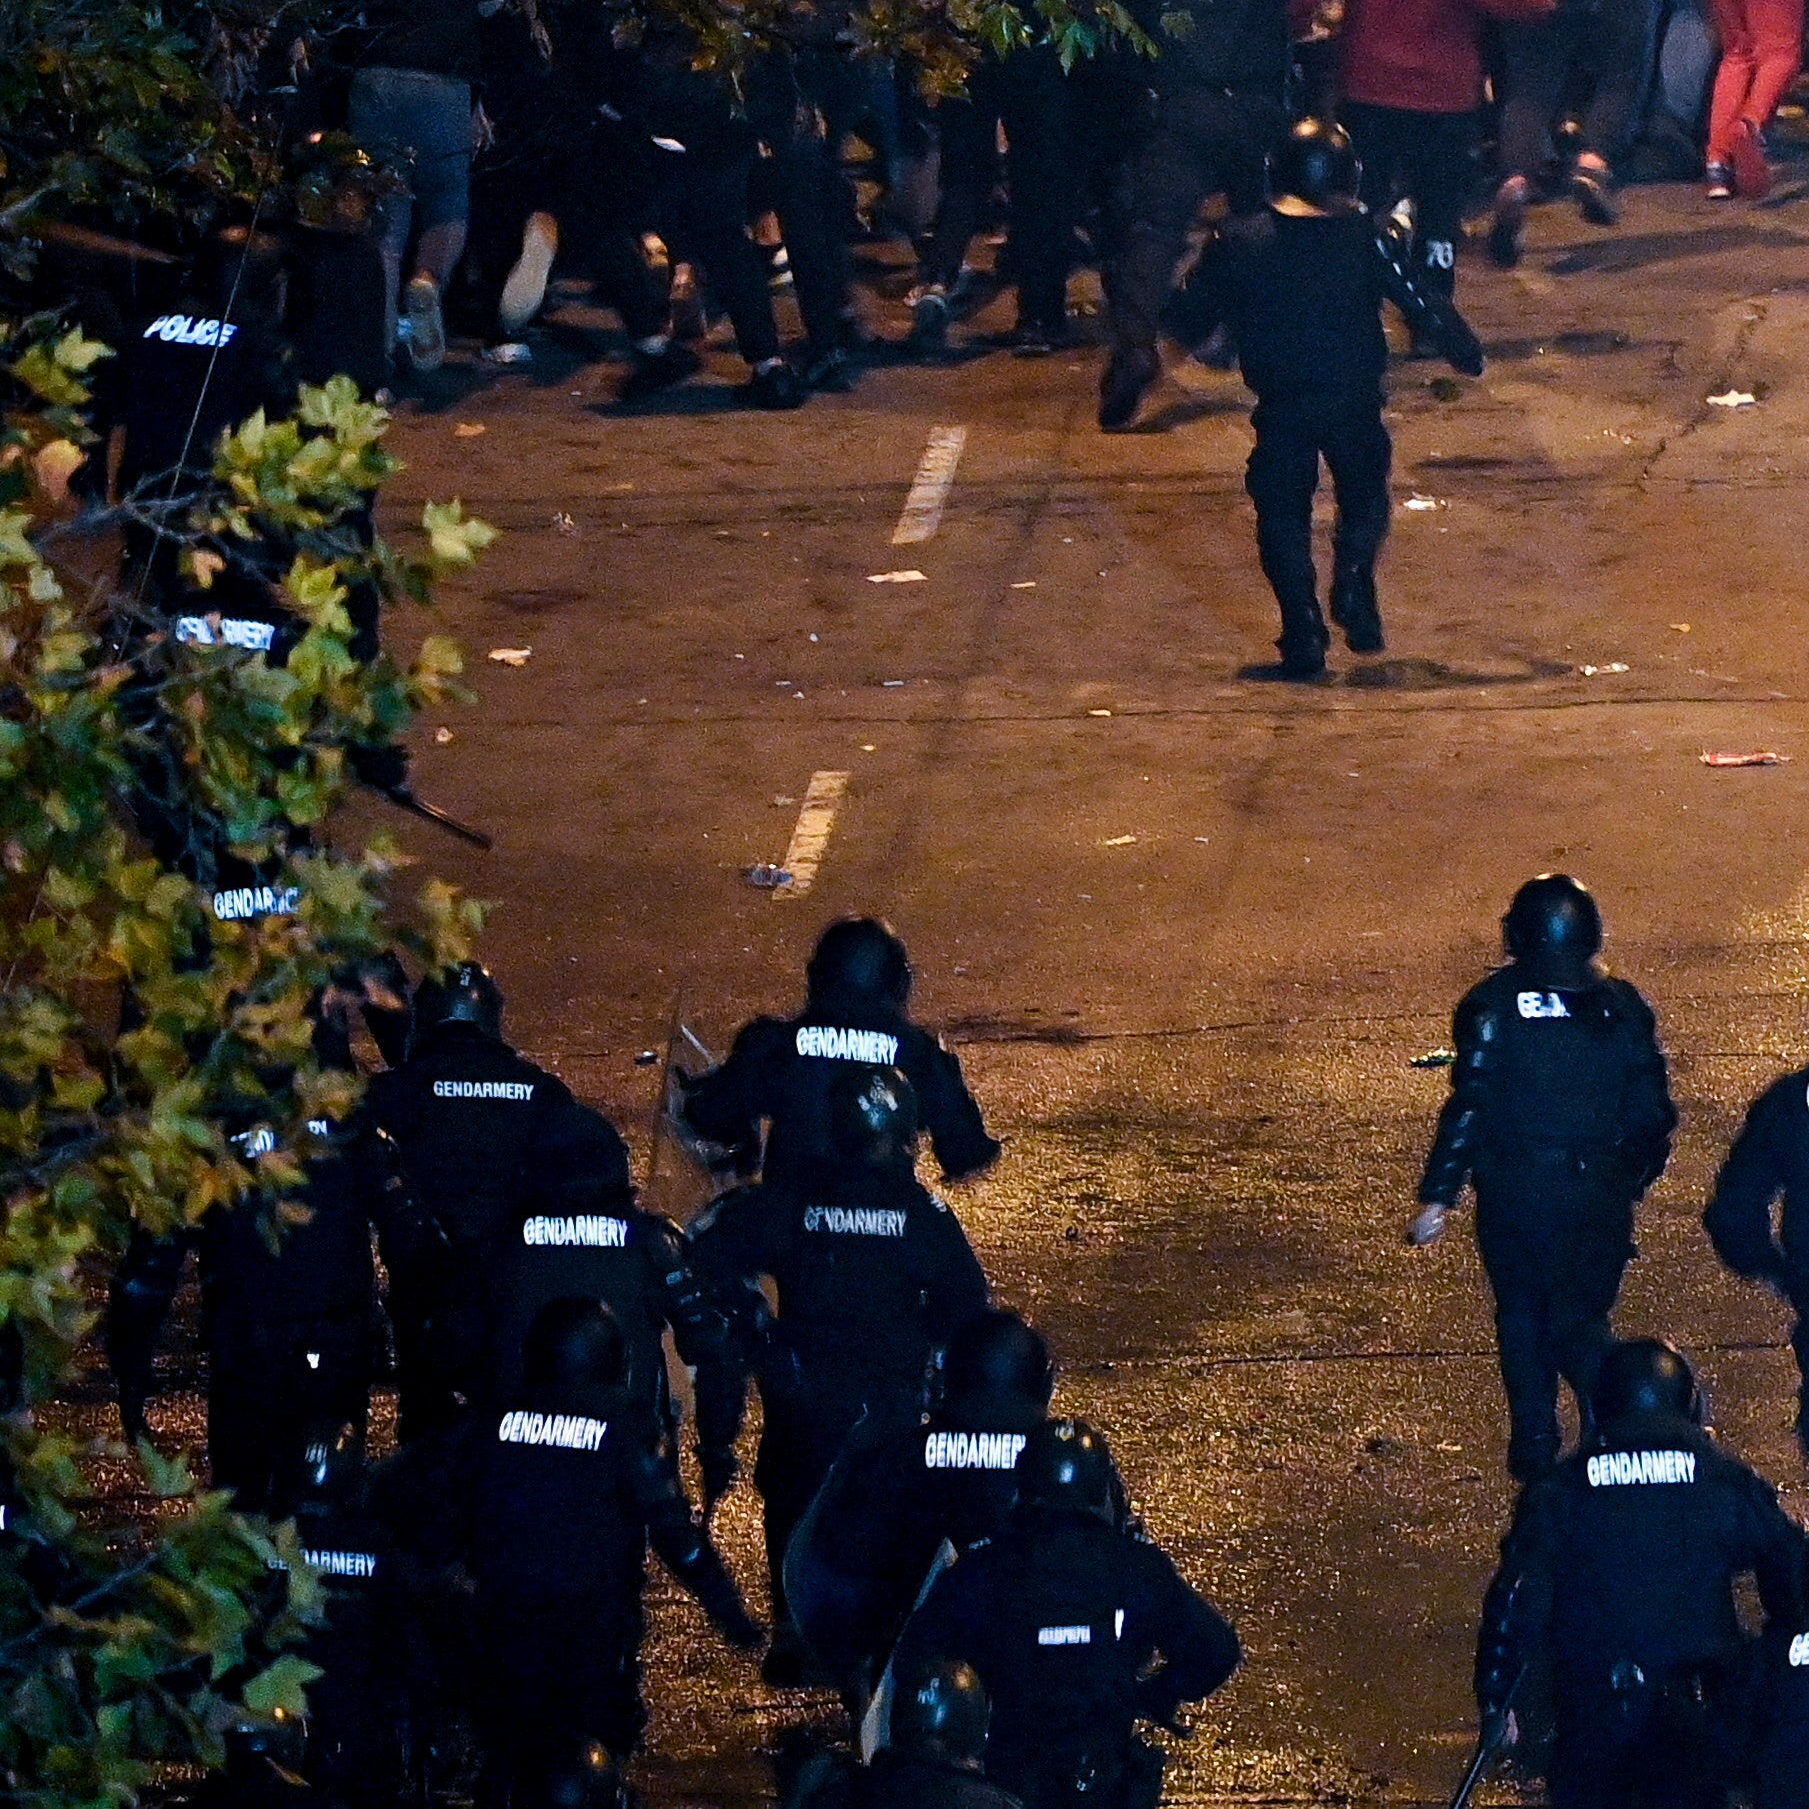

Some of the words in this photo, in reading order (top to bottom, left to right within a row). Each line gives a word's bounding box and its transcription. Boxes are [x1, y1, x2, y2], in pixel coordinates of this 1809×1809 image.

[143, 314, 238, 348] POLICE
[795, 1026, 899, 1066] GENDARMERY
[433, 1080, 534, 1101] GENDARMERY
[522, 1214, 628, 1247] GENDARMERY
[498, 1410, 608, 1452] GENDARMERY
[924, 1432, 1027, 1470] GENDARMER
[1586, 1450, 1696, 1487] GENDARMERY
